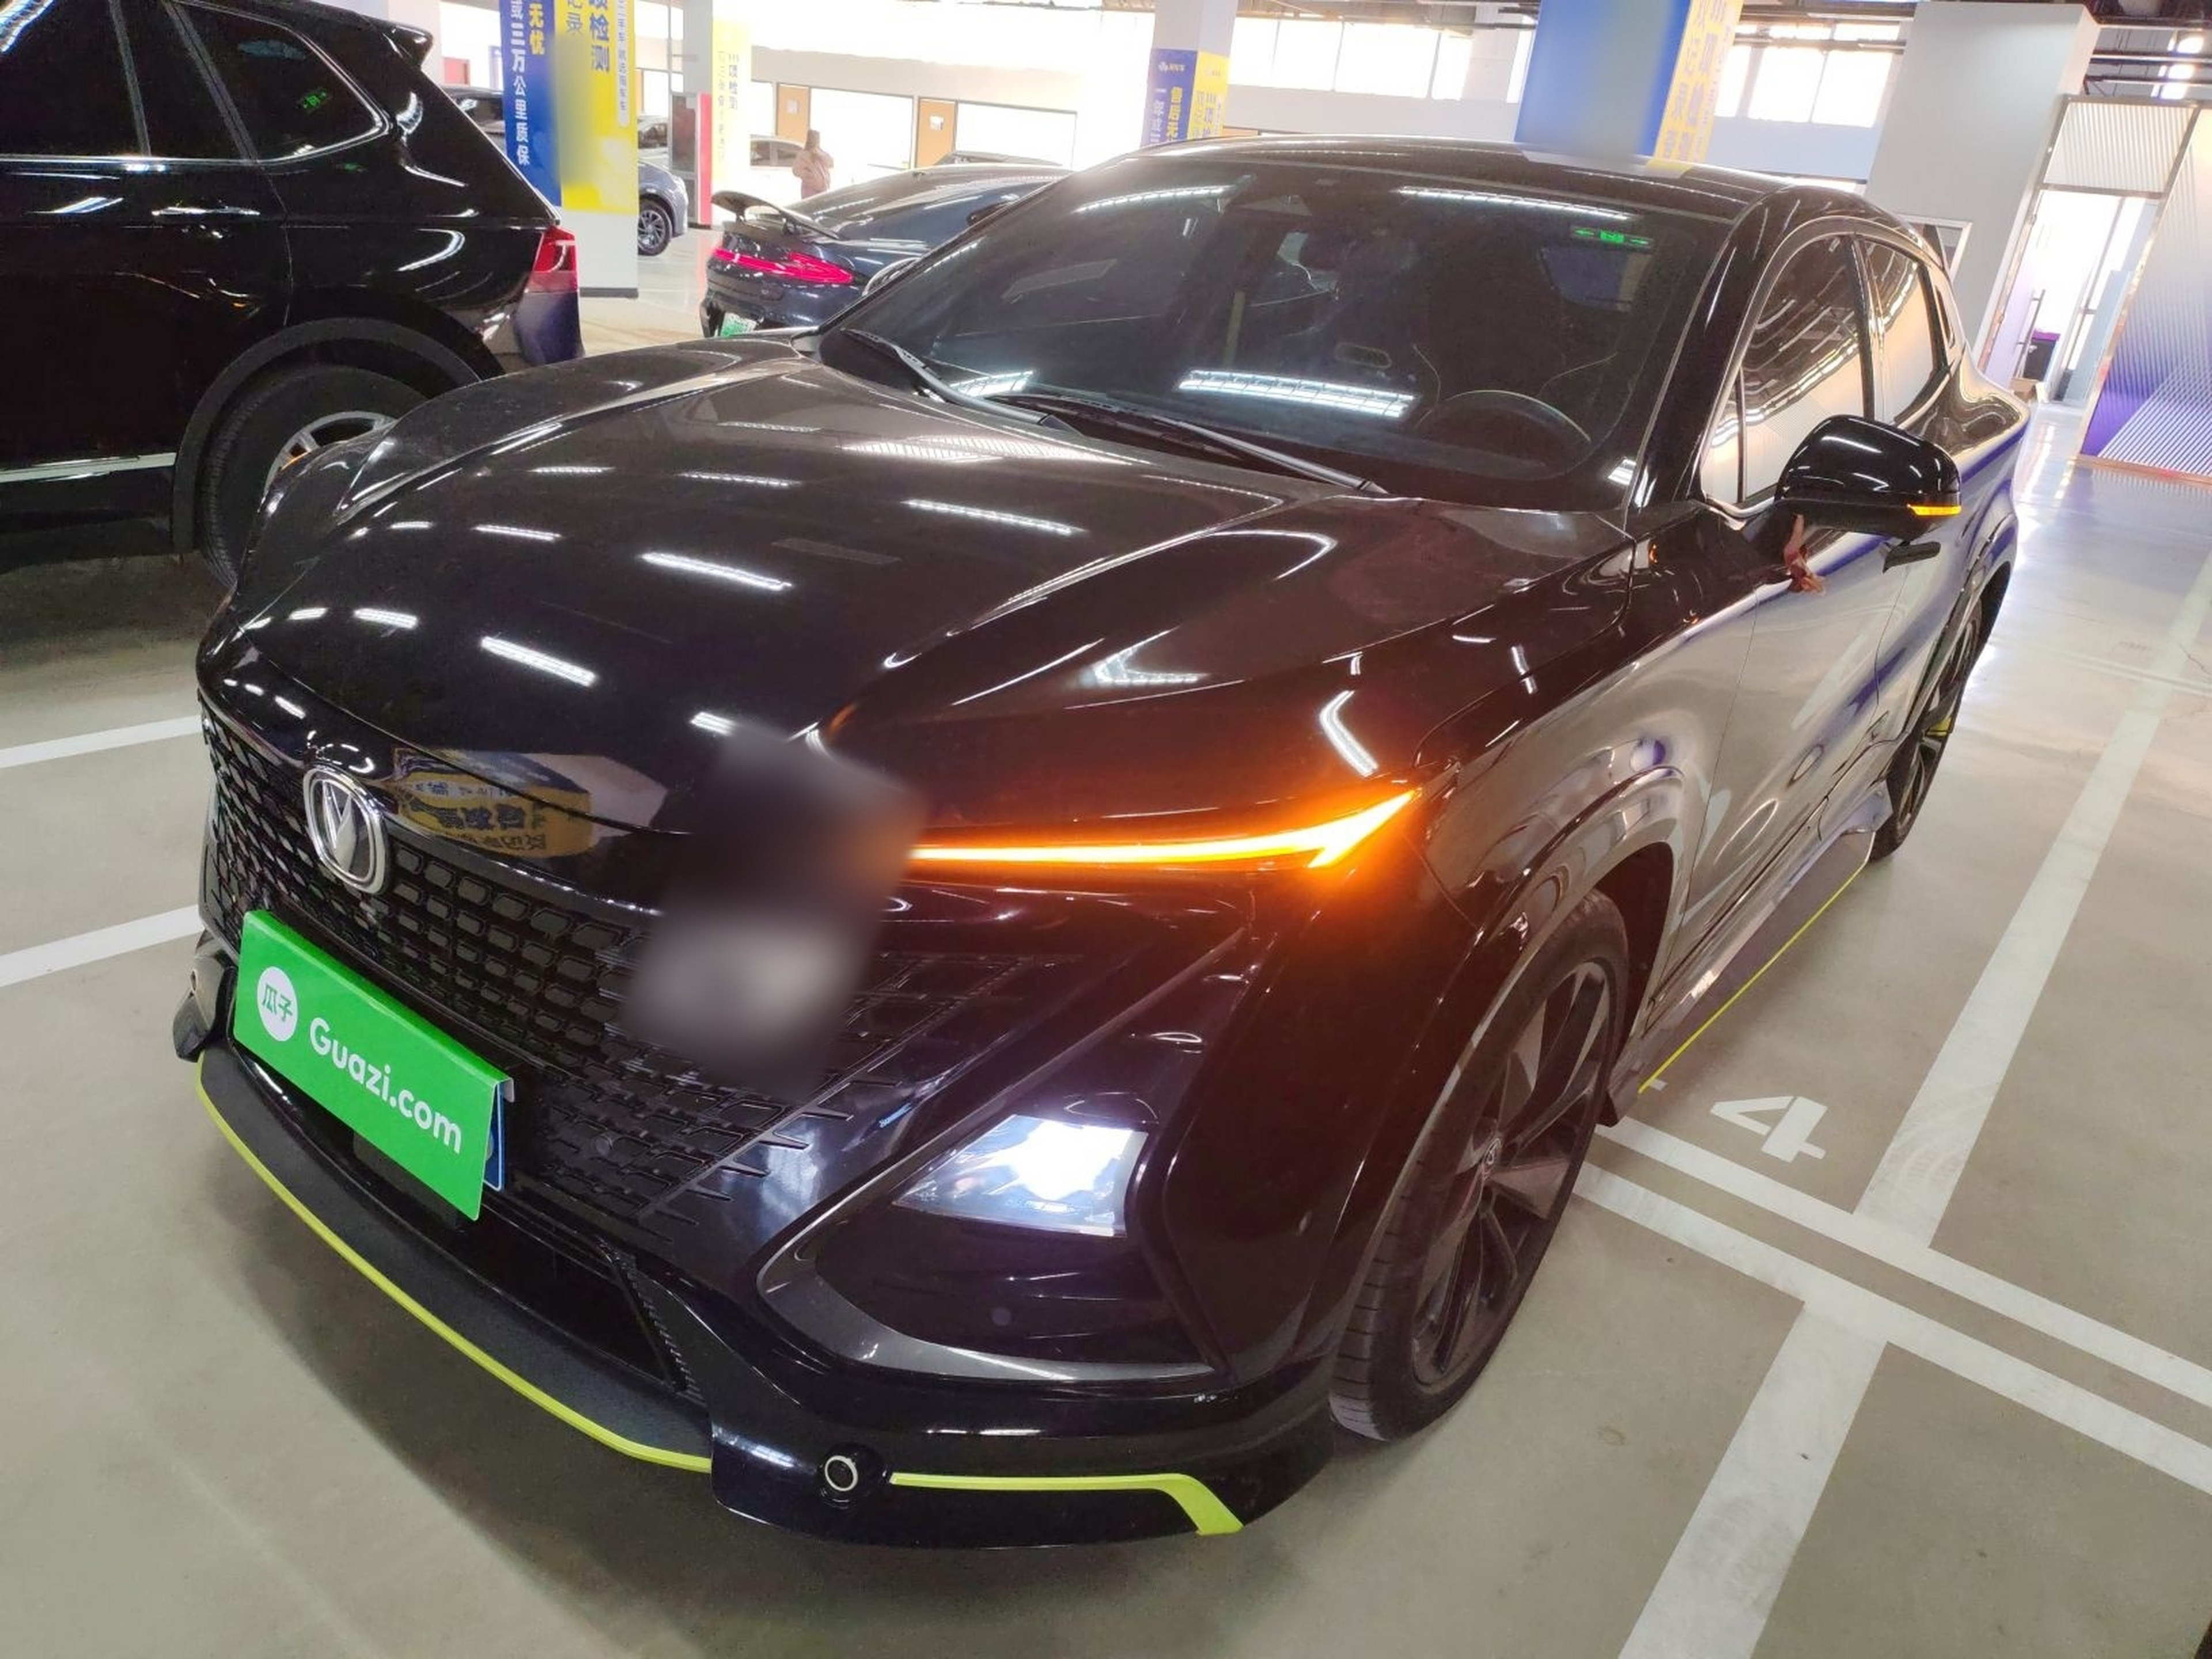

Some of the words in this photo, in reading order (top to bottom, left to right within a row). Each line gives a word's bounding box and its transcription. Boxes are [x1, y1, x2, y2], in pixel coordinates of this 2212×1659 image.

[261, 983, 294, 1022] 瓜子
[309, 1017, 463, 1155] Guazi.com
[1710, 1095, 1829, 1163] 4
